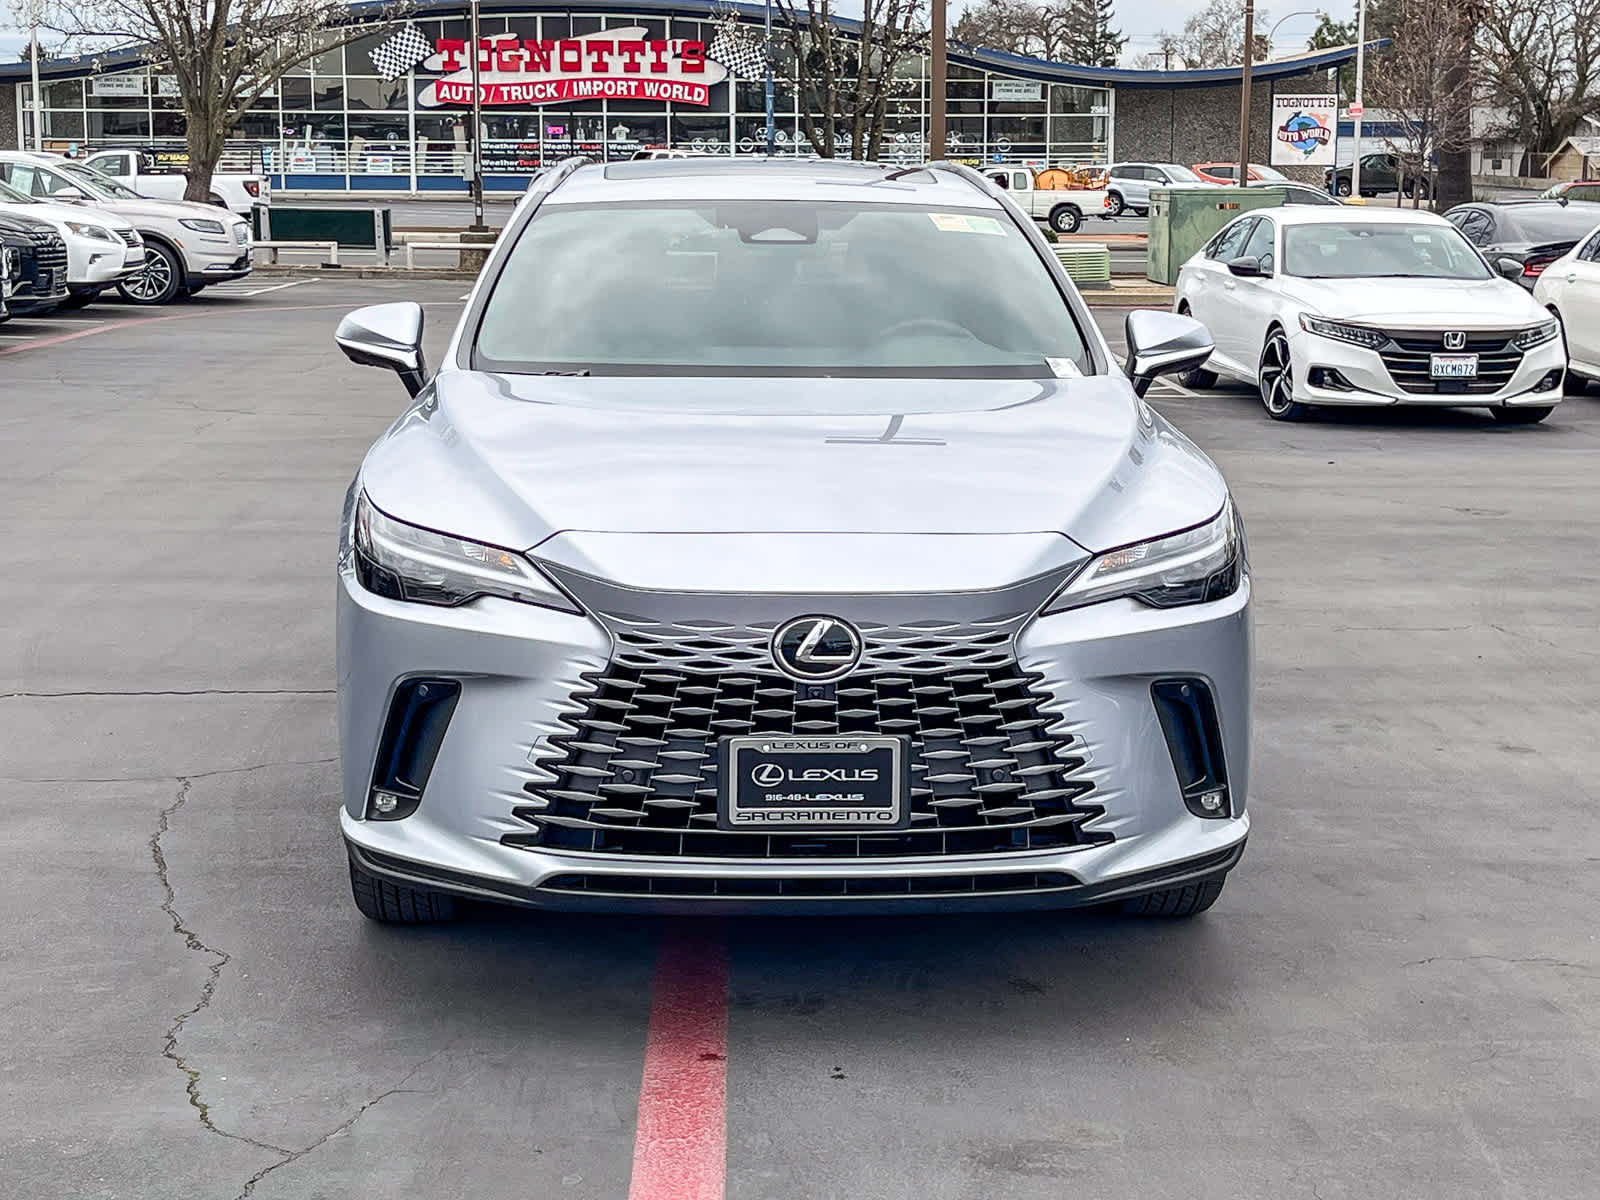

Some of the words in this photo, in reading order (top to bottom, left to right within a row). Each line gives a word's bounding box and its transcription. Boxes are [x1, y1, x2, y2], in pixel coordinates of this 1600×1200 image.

[436, 38, 705, 73] TOGNOTTI'S
[500, 83, 558, 101] TRUCK
[572, 80, 638, 97] IMPORT
[644, 81, 706, 101] WORLD
[1275, 96, 1336, 108] TOGNOTTI'S
[788, 768, 879, 781] LEXUS
[765, 793, 865, 801] 916-48-LEXUS
[735, 811, 893, 821] SACRAMENTO
